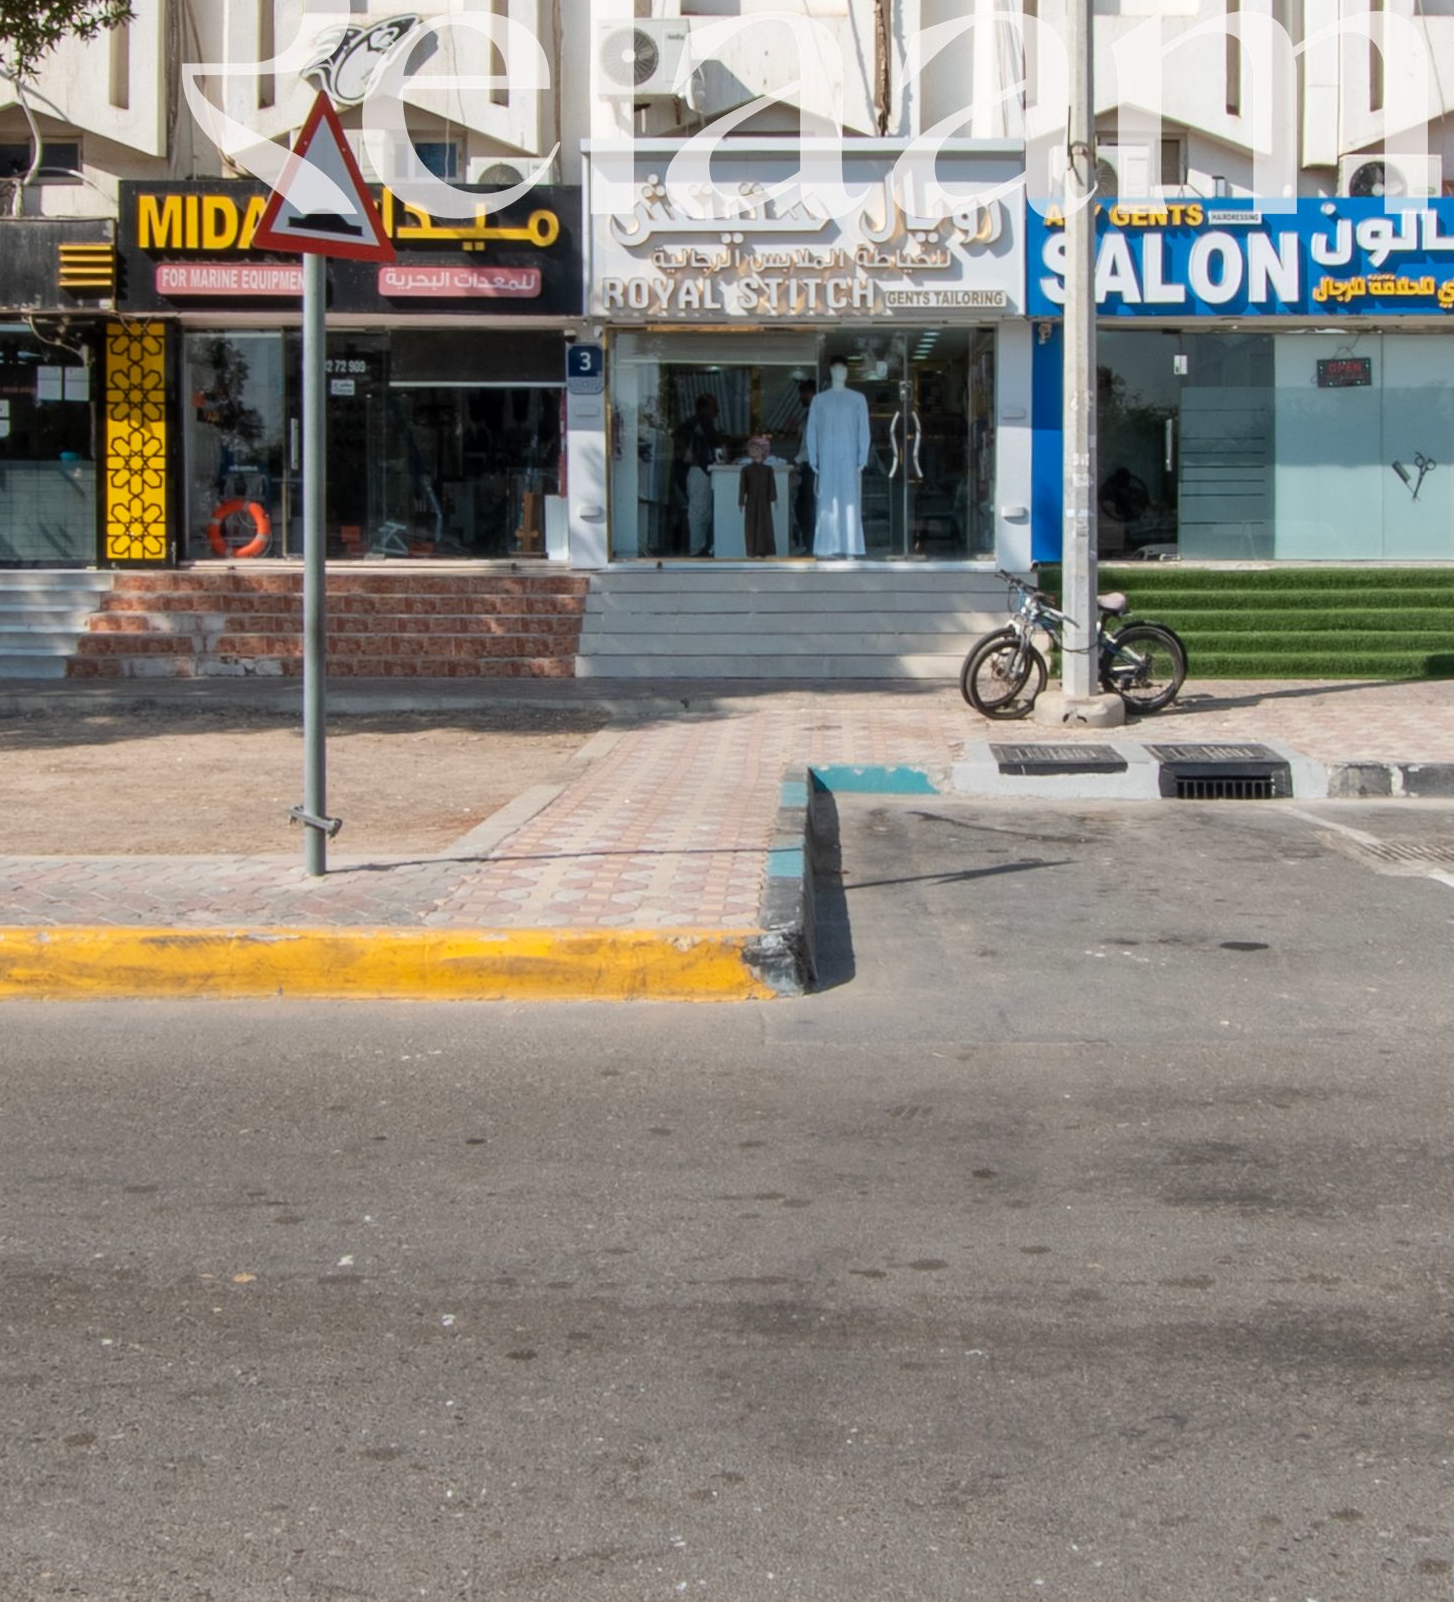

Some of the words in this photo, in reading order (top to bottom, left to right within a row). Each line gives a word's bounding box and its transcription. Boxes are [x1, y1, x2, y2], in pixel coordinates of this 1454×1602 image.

[856, 168, 1005, 244] رويال
[1109, 203, 1203, 228] GENTS
[137, 194, 269, 251] MIDA
[650, 245, 741, 274] الرجالية
[749, 246, 846, 273] الملابس
[1039, 231, 1300, 305] SALON
[161, 268, 188, 288] FOR
[190, 269, 238, 289] MARINE
[241, 270, 305, 291] EQUIPMEN
[384, 269, 450, 291] البحرية
[453, 273, 536, 291] للمعدات
[602, 277, 722, 310] ROYAL
[737, 277, 875, 310] STITCH
[887, 291, 931, 306] GENTS
[933, 291, 1005, 306] TAILORING
[579, 351, 592, 372] 3
